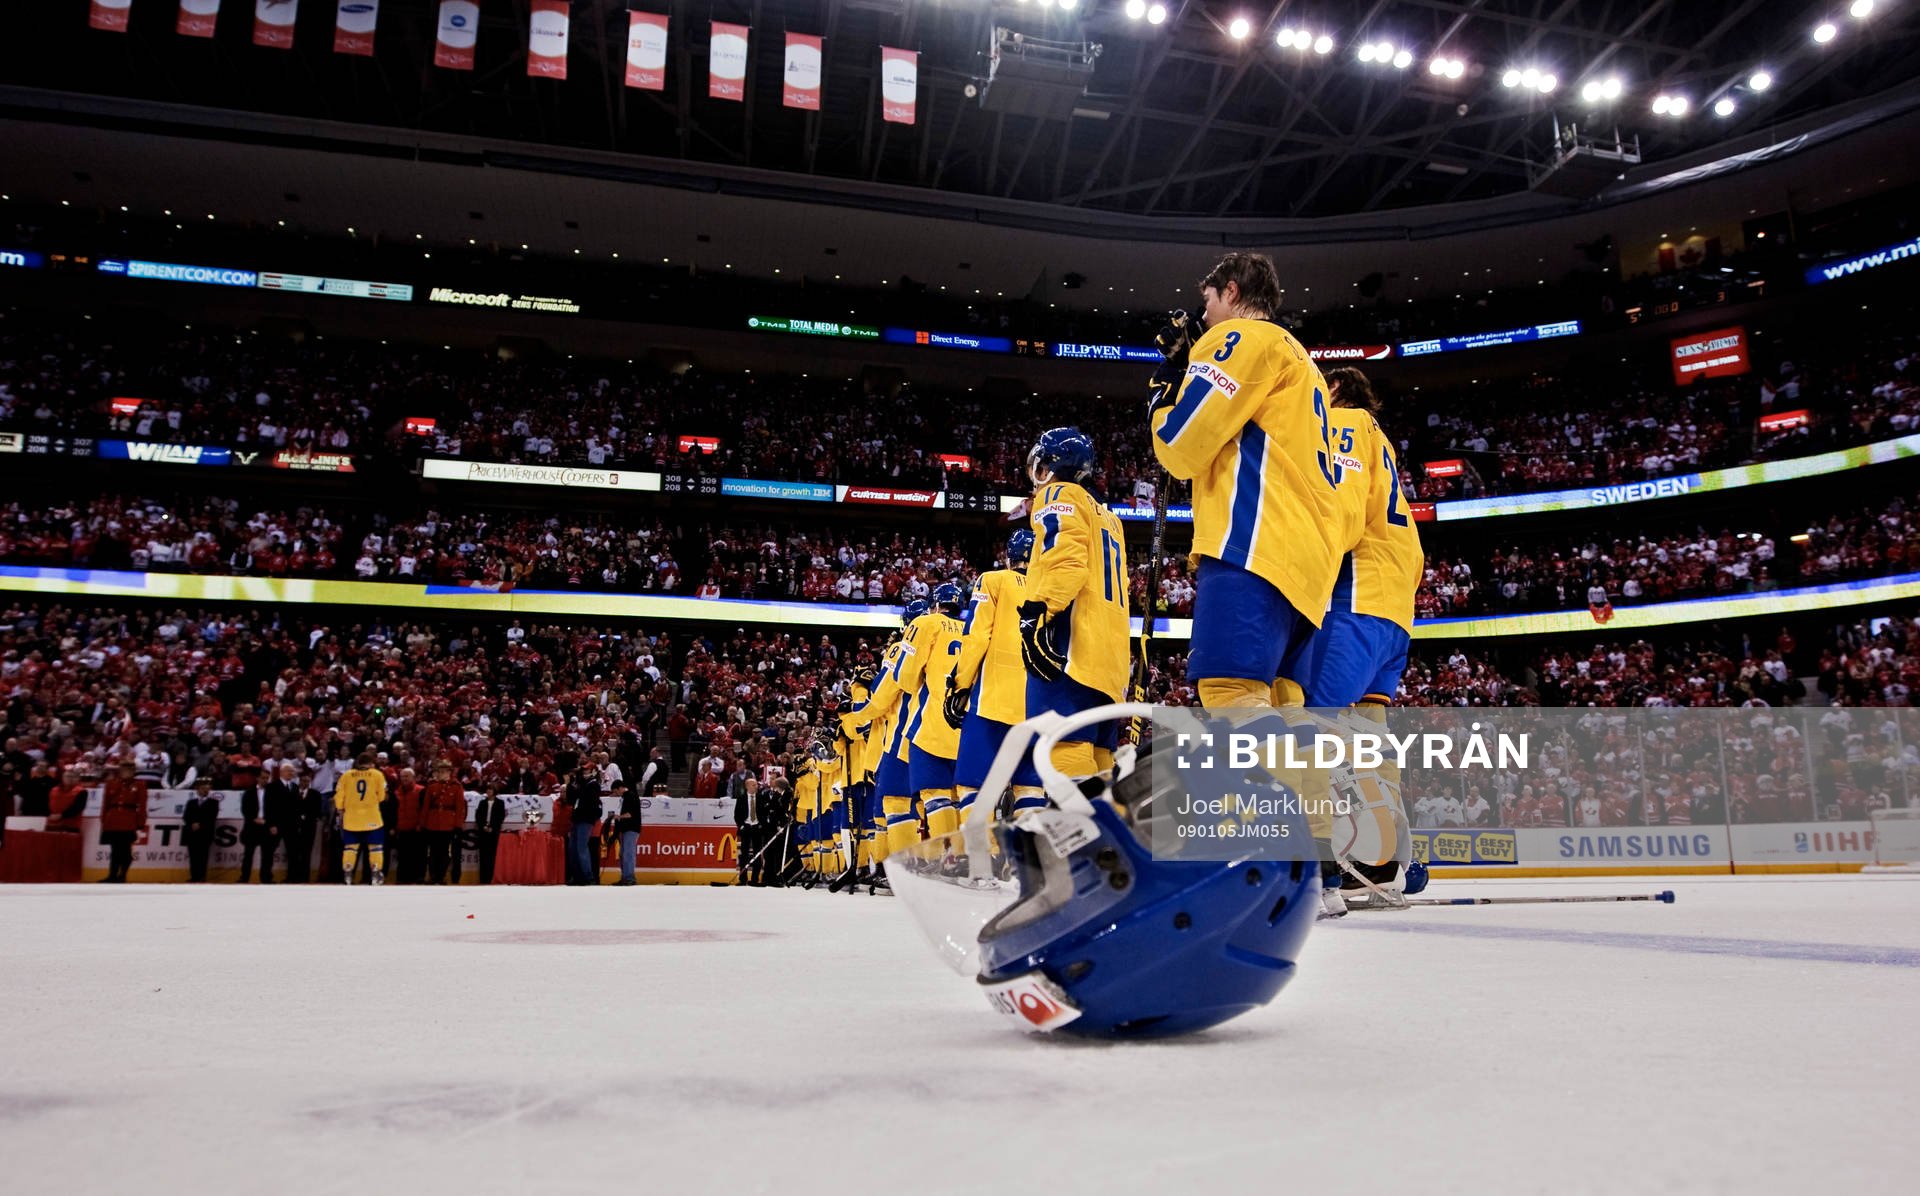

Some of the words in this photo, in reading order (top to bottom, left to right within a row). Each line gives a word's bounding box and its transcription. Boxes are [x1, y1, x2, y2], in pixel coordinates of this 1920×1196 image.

[128, 261, 256, 286] SPIRENTCOM.COM
[429, 287, 512, 307] Microsoft
[511, 299, 531, 309] SENS
[532, 301, 580, 313] FOUNDATION
[789, 319, 813, 330] TOTAL
[814, 321, 839, 332] MEDIA
[931, 334, 952, 345] Direct
[953, 336, 979, 348] Energy
[1213, 331, 1242, 362] 3
[1310, 350, 1324, 360] RV
[1324, 349, 1365, 359] CANADA
[665, 474, 682, 483] 308
[700, 476, 718, 485] 309
[664, 484, 681, 492] 208
[700, 485, 717, 494] 209
[722, 481, 768, 494] innovation
[768, 483, 781, 495] for
[782, 485, 811, 498] growth
[813, 488, 832, 498] IBM
[850, 489, 891, 501] CURTISS
[893, 491, 932, 503] WRIGHT
[1044, 485, 1065, 505] 17
[1591, 477, 1690, 506] SWEDEN
[949, 492, 964, 501] 309
[983, 495, 997, 504] 310
[949, 501, 964, 509] 209
[983, 502, 997, 511] 210
[1101, 527, 1125, 609] 17
[904, 624, 919, 643] 21
[889, 645, 900, 659] 8
[356, 779, 367, 801] 9
[656, 841, 701, 856] lovin'
[703, 841, 715, 856] it
[1437, 838, 1471, 850] BEST
[1480, 837, 1514, 849] BEST
[1558, 834, 1712, 859] SAMSUNG
[1439, 847, 1468, 859] BUY
[1481, 846, 1510, 858] BUY
